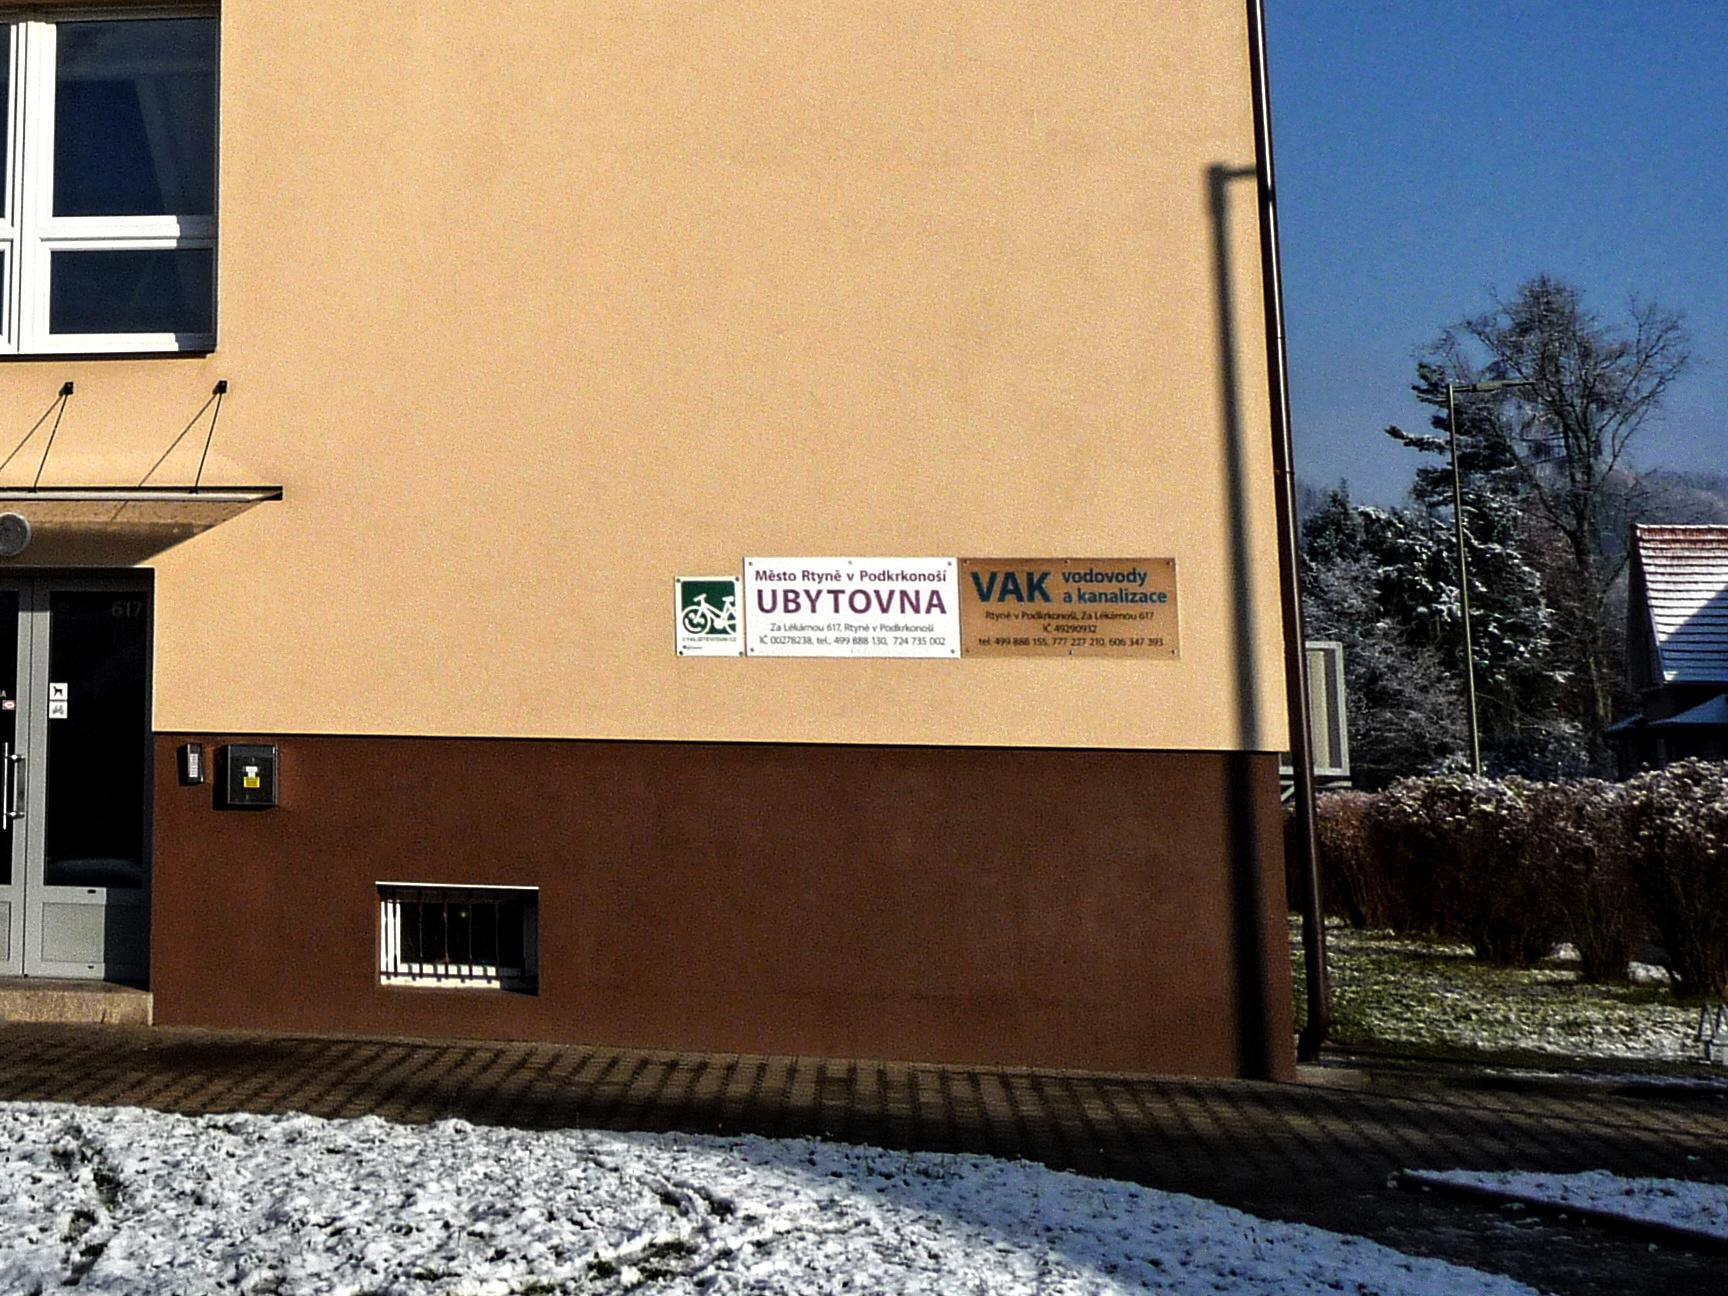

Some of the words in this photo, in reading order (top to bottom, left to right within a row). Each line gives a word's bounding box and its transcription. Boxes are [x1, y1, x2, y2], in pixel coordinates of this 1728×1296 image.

[755, 570, 797, 582] Město
[802, 570, 842, 585] Rtyně
[847, 573, 855, 582] v
[860, 570, 947, 582] Podkrkonoší
[1062, 568, 1148, 587] vodovody
[970, 571, 1052, 603] VAK
[757, 589, 947, 614] UBYTOVNA
[1063, 592, 1073, 603] a
[1077, 588, 1168, 603] kanalizace
[1139, 612, 1155, 620] 617
[770, 623, 782, 632] Za
